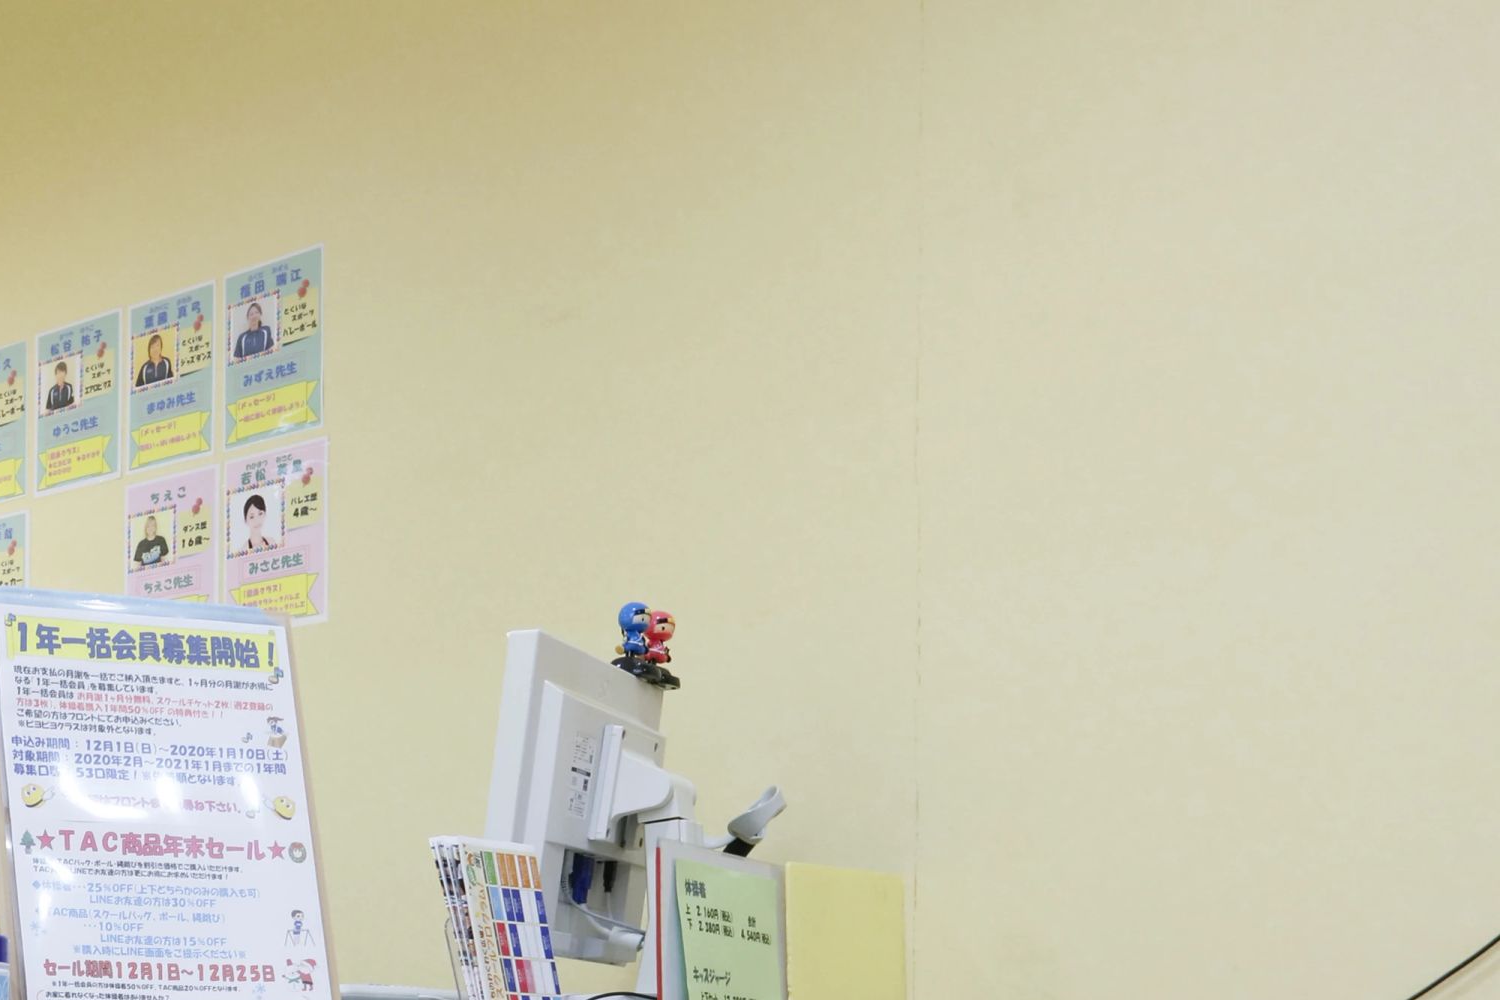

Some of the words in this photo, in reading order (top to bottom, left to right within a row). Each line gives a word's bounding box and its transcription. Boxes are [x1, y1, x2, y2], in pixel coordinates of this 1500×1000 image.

[243, 361, 297, 388] みずえ先生
[146, 391, 196, 415] まゆみ先生
[52, 415, 99, 438] ゆうこ先生
[150, 486, 187, 504] ちえこ
[248, 553, 304, 575] みさと先生
[143, 574, 194, 594] ちえこ先生
